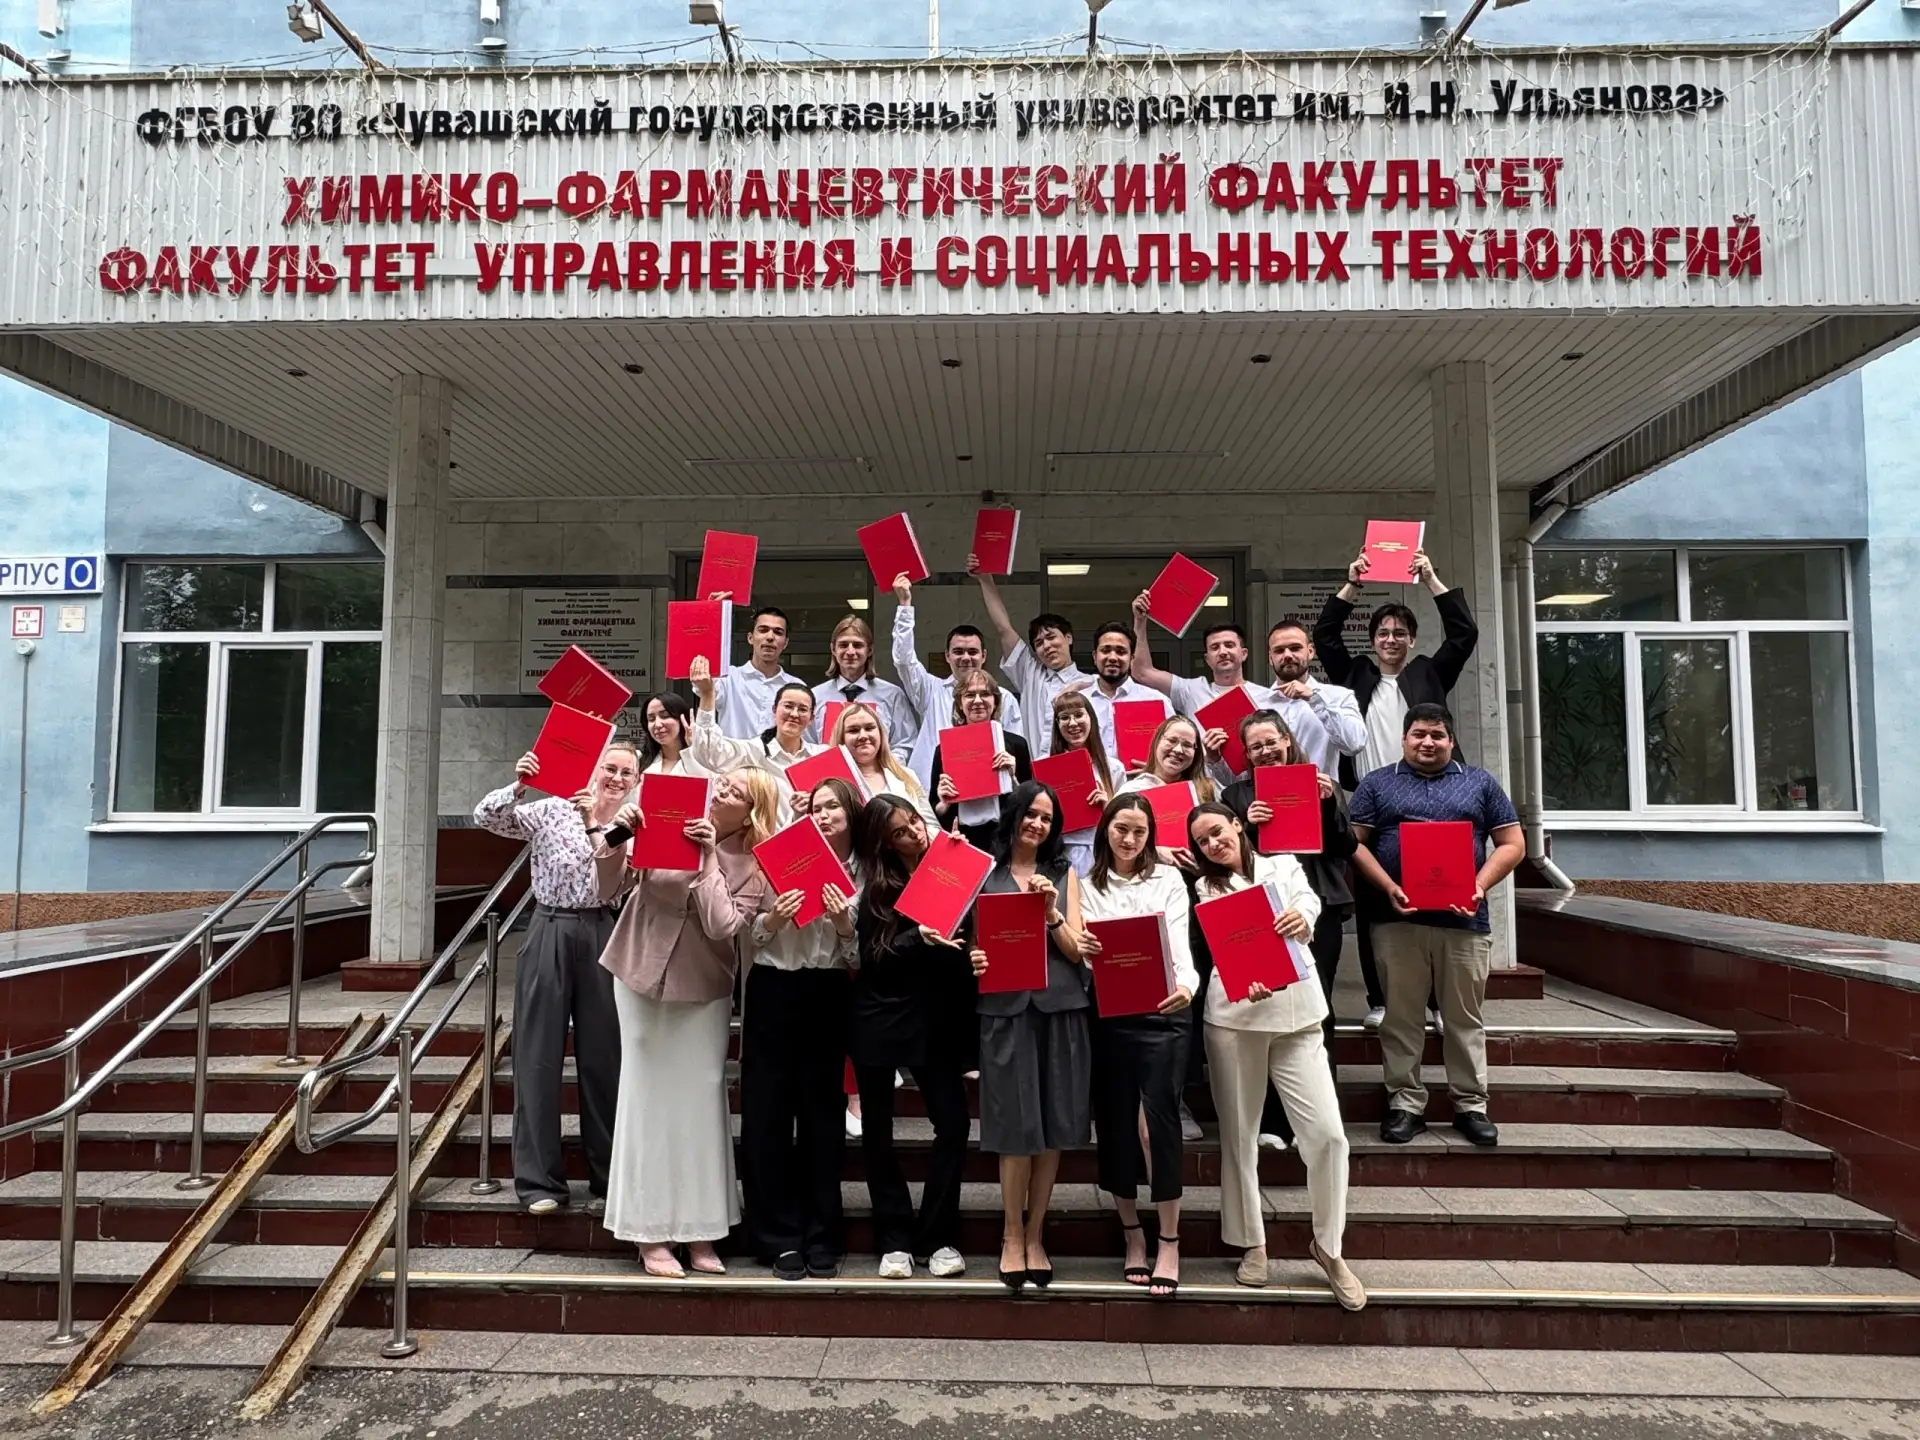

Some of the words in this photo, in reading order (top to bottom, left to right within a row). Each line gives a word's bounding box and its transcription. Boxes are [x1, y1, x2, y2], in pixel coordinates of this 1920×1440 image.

[137, 105, 276, 145] ФГБОУ
[291, 104, 342, 140] ВО
[628, 93, 997, 141] государственный
[1015, 94, 1277, 137] университет
[1208, 158, 1564, 213] ФАКУЛЬТЕТ
[100, 242, 435, 296] ФАКУЛЬТЕТ
[475, 236, 856, 293] УПРАВЛЕНИЯ
[880, 237, 913, 288] И
[936, 231, 1349, 296] СОЦИАЛЬНЫХ
[1372, 213, 1762, 281] ТЕХНОЛОГИЙ
